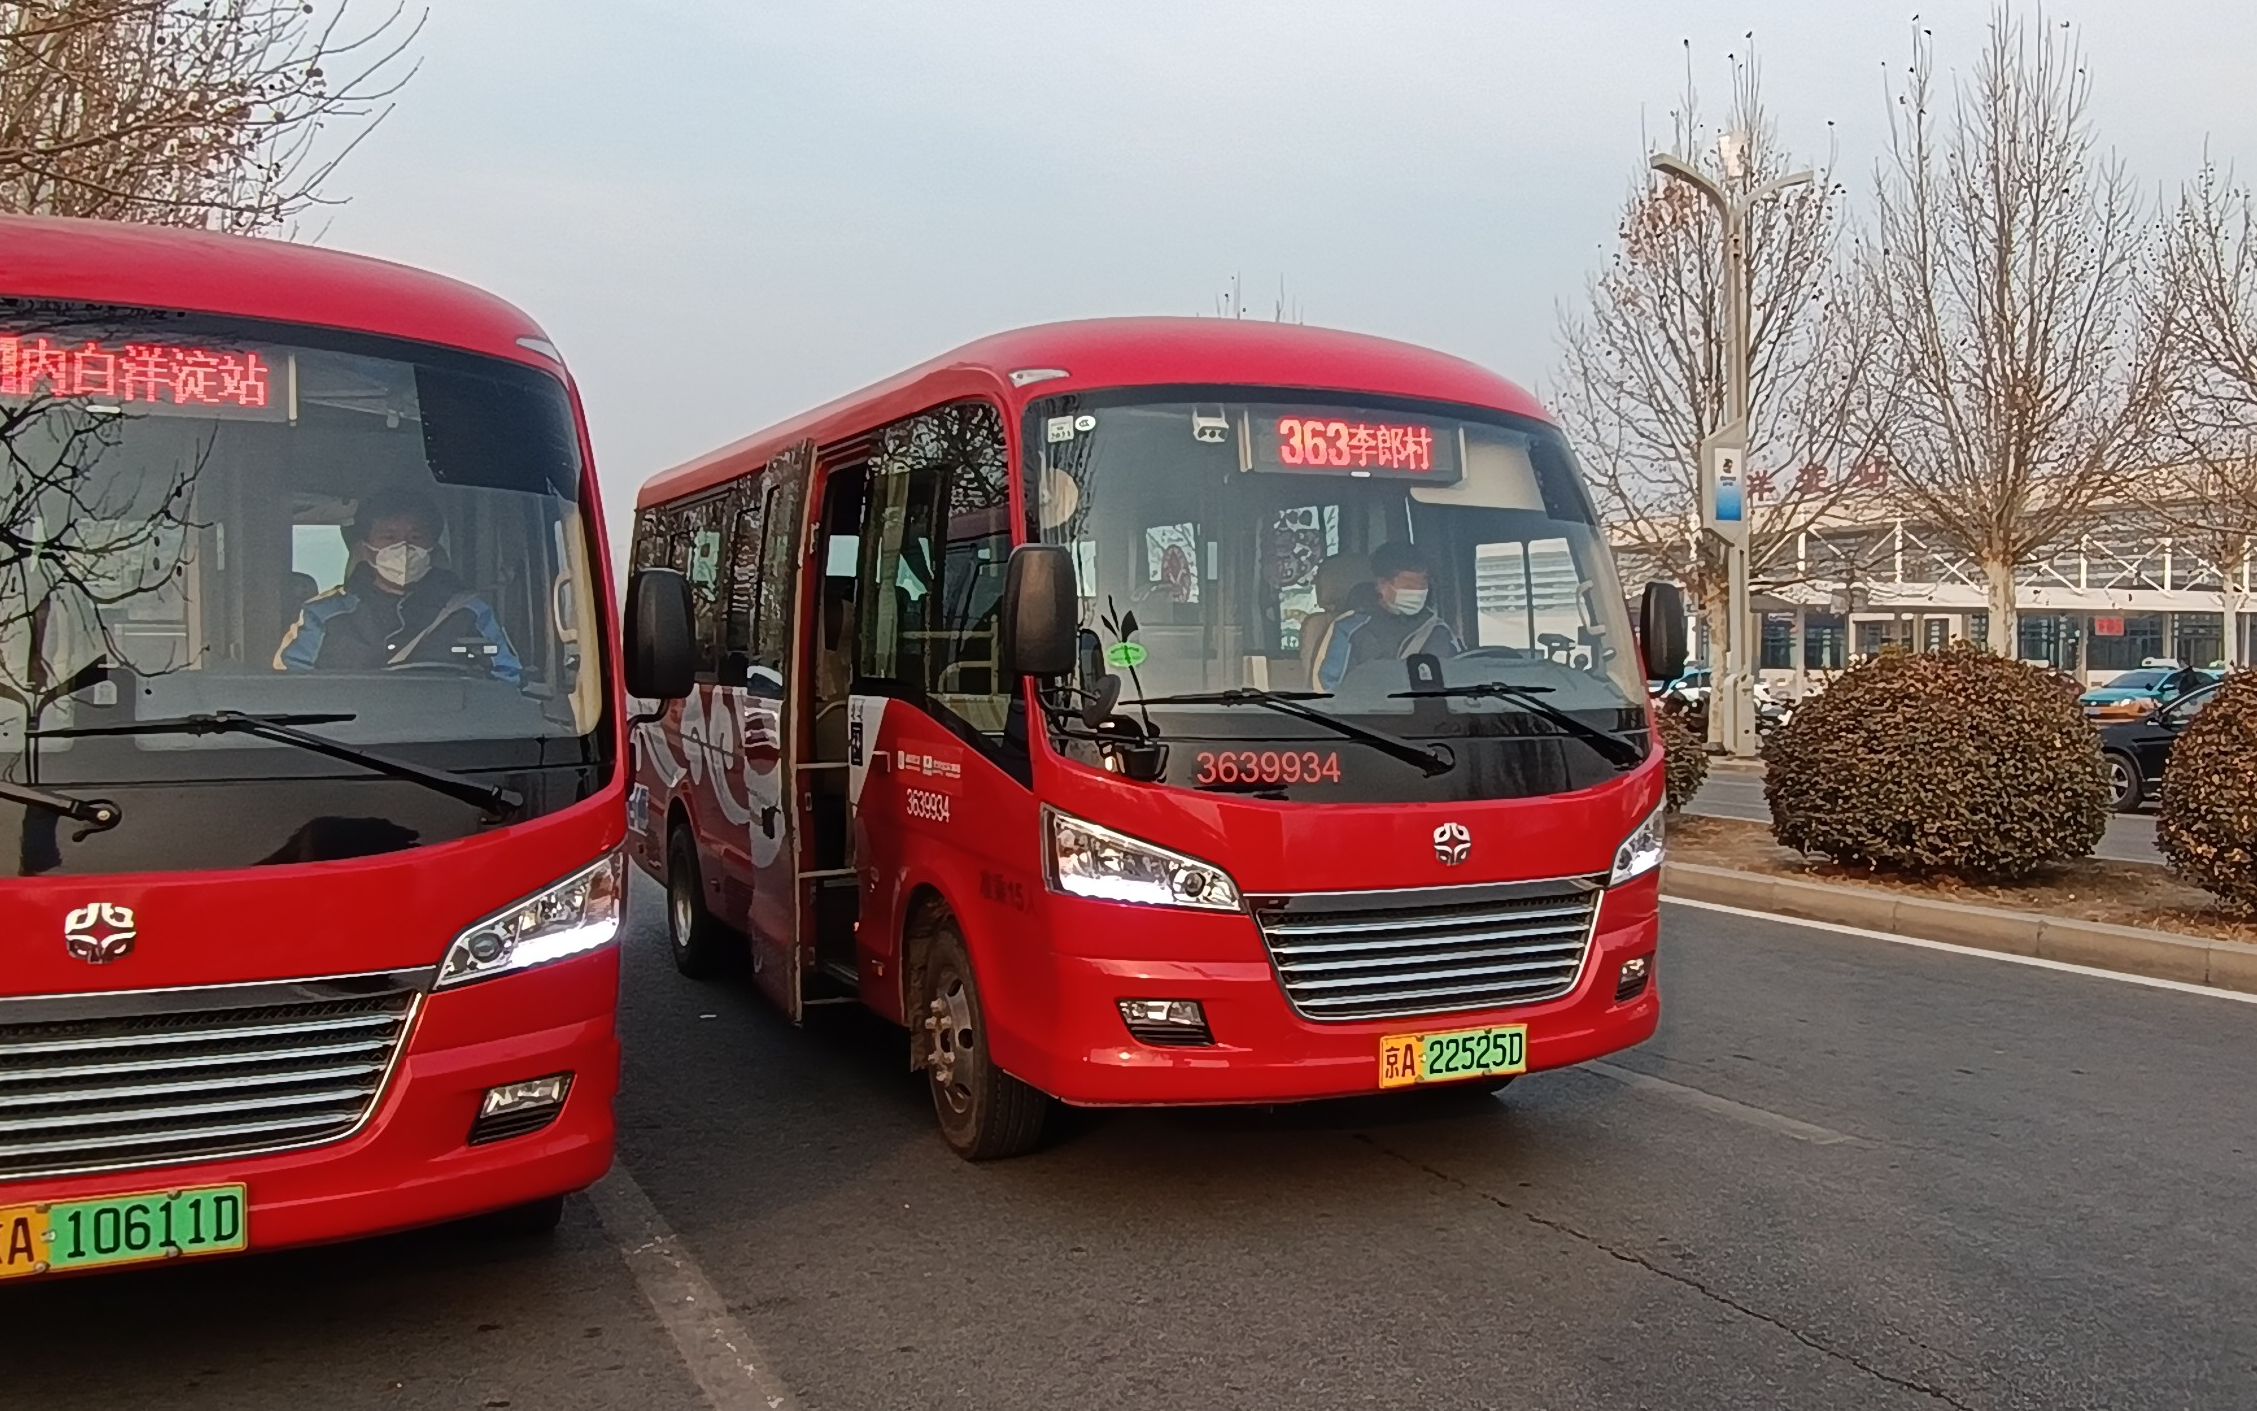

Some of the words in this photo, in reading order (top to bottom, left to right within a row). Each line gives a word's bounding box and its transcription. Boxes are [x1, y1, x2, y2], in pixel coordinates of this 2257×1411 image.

[1197, 751, 1341, 783] 3639934
[906, 788, 950, 823] 3639934
[0, 1217, 34, 1265] A
[66, 1194, 239, 1258] 10611D
